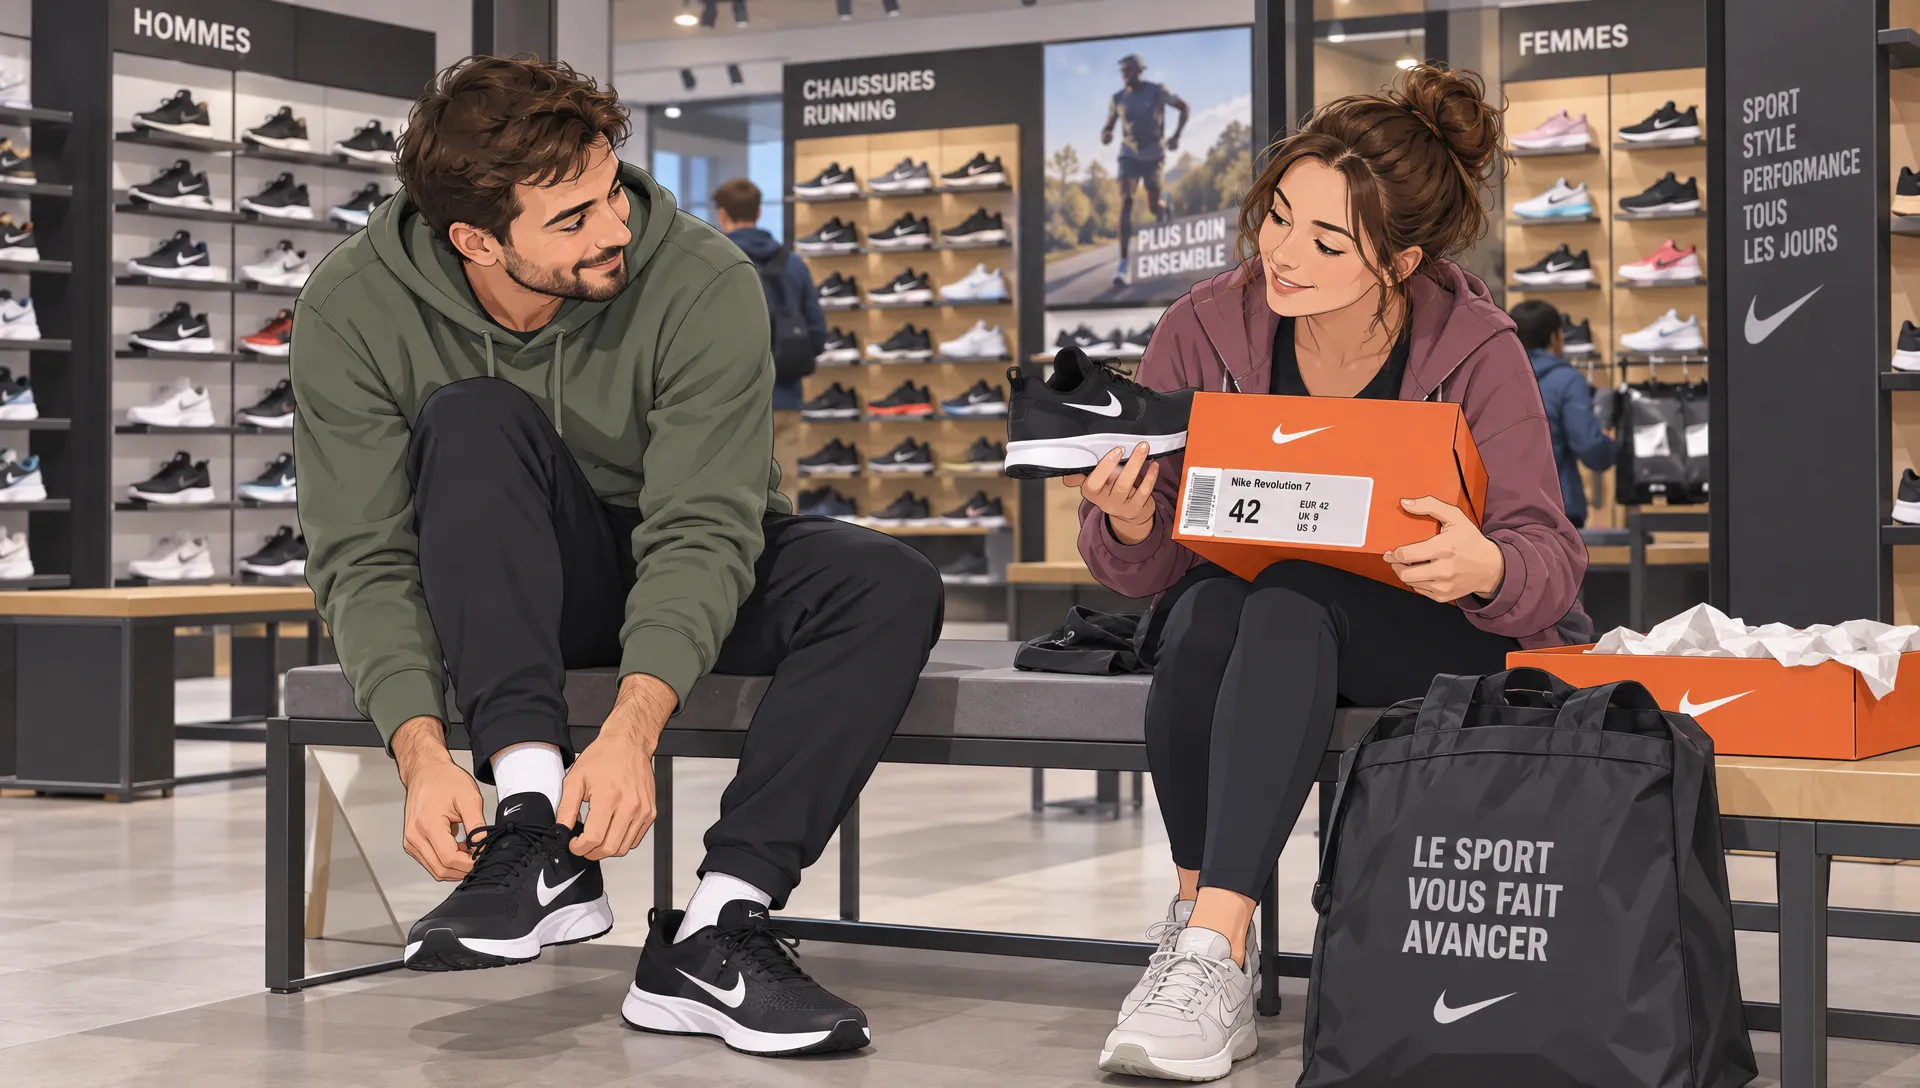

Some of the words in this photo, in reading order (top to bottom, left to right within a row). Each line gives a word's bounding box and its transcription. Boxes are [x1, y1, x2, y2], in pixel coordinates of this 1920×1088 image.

[134, 7, 251, 54] HOMMES
[1519, 23, 1629, 57] FEMMES
[803, 69, 936, 100] CHAUSSURES
[804, 98, 897, 126] RUNNING
[1743, 87, 1800, 124] SPORT
[1743, 124, 1797, 159] STYLE
[1743, 147, 1861, 194] PERFORMANCE
[1743, 198, 1788, 231] TOUS
[1137, 224, 1182, 252] PLUS
[1186, 216, 1226, 244] LOIN
[1744, 235, 1775, 265] LES
[1779, 224, 1838, 259] JOURS
[1137, 244, 1226, 278] ENSEMBLE
[1231, 477, 1252, 488] Nike
[1254, 479, 1302, 491] Revolution
[1305, 481, 1312, 491] 7
[1228, 498, 1261, 524] 42
[1298, 511, 1311, 521] UK
[1299, 499, 1317, 510] EUR
[1319, 501, 1330, 511] 42
[1297, 523, 1309, 533] US
[1312, 524, 1318, 533] 9
[1413, 836, 1447, 868] LE
[1454, 838, 1555, 874] SPORT
[1408, 876, 1487, 914] VOUS
[1496, 882, 1564, 918] FAIT
[1402, 919, 1548, 962] AVANCER
